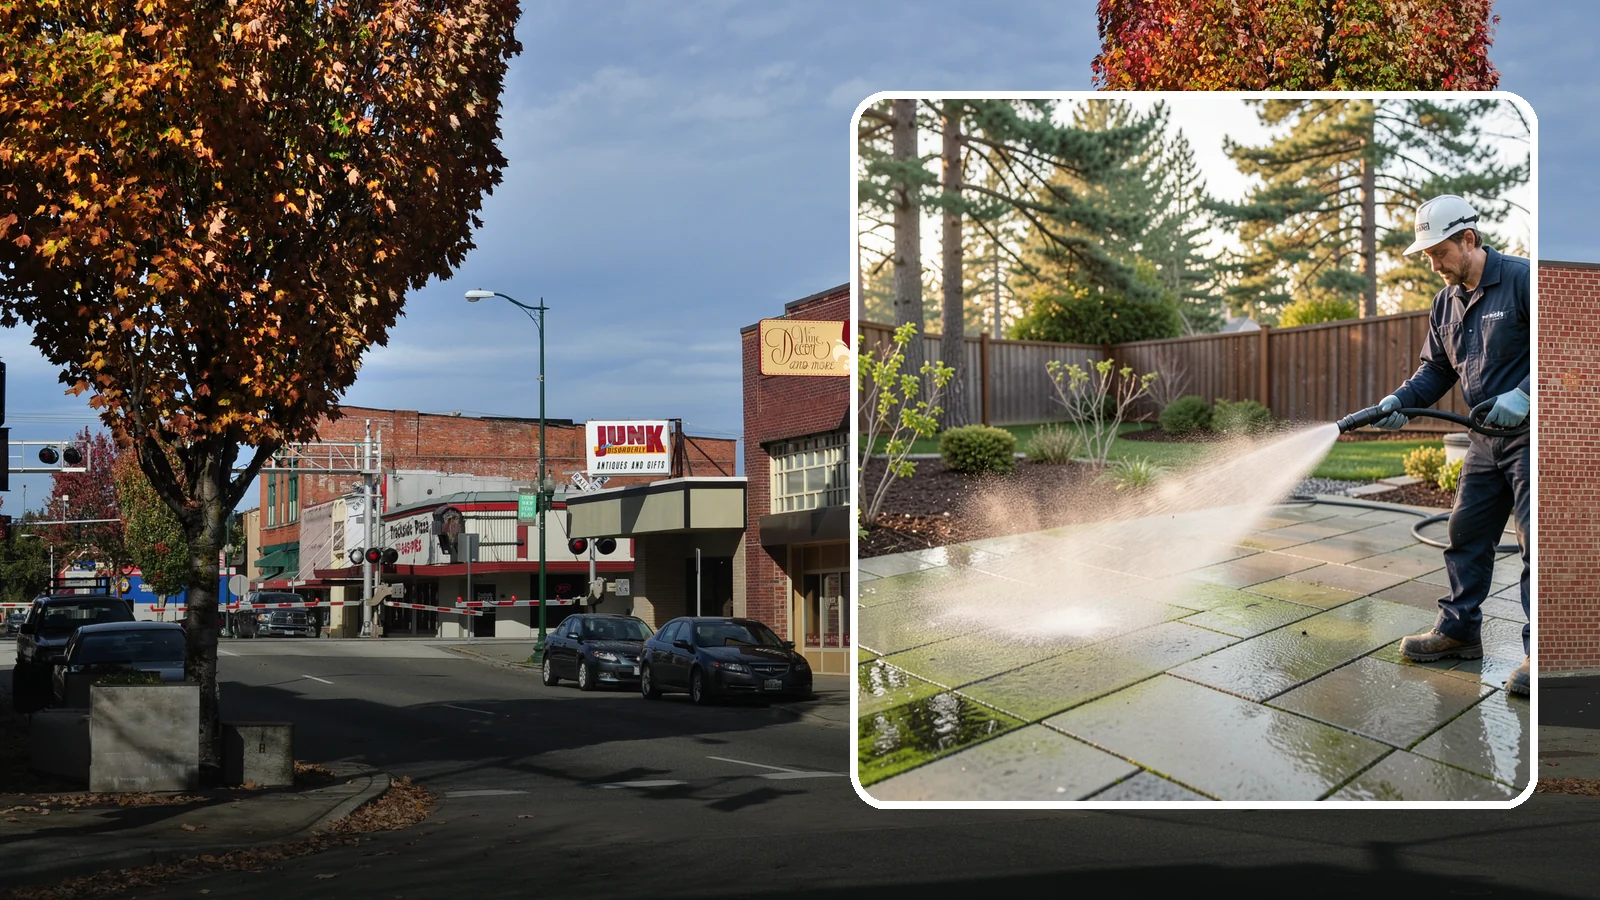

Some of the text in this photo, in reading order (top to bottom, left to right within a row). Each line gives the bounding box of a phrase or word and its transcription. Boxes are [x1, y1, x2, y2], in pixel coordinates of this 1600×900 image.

[595, 425, 665, 457] JUNK
[607, 446, 646, 454] DISORDERLY
[597, 461, 665, 470] ANTIQUES AND GIFTS
[390, 520, 429, 540] Trackside Pizza
